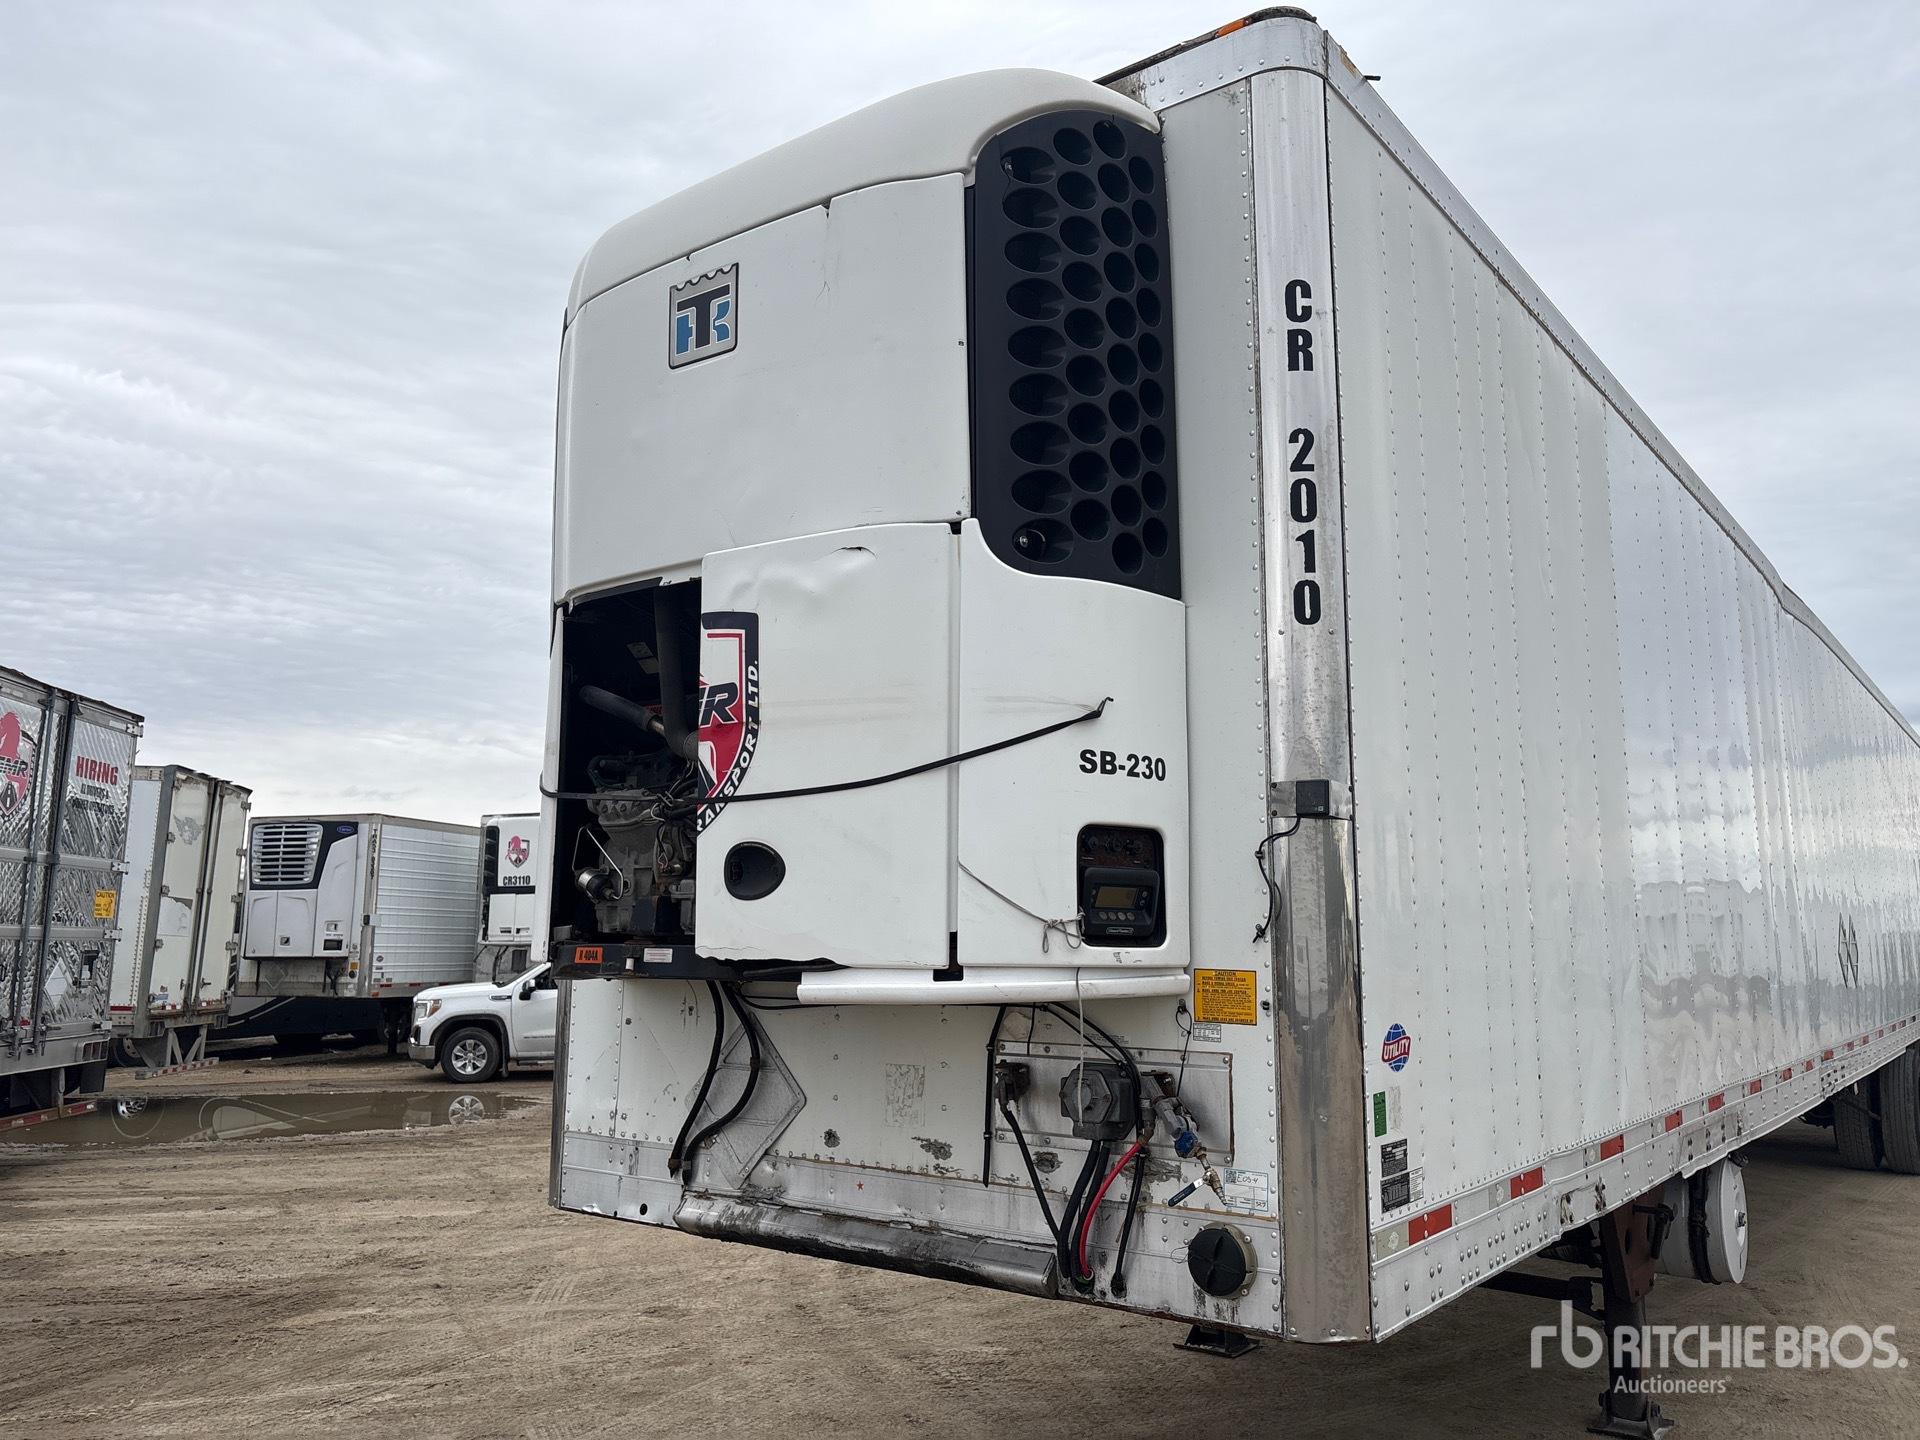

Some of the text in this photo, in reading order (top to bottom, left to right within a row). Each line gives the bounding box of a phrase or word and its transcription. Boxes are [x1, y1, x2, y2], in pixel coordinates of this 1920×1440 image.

[1284, 279, 1322, 626] CR 2010
[697, 660, 759, 832] RANSPORT LTD.
[75, 755, 118, 786] HIRING
[1079, 749, 1166, 781] SB-230
[503, 875, 531, 886] CR3110
[584, 949, 599, 961] 404A
[1383, 1039, 1410, 1060] UTILITY
